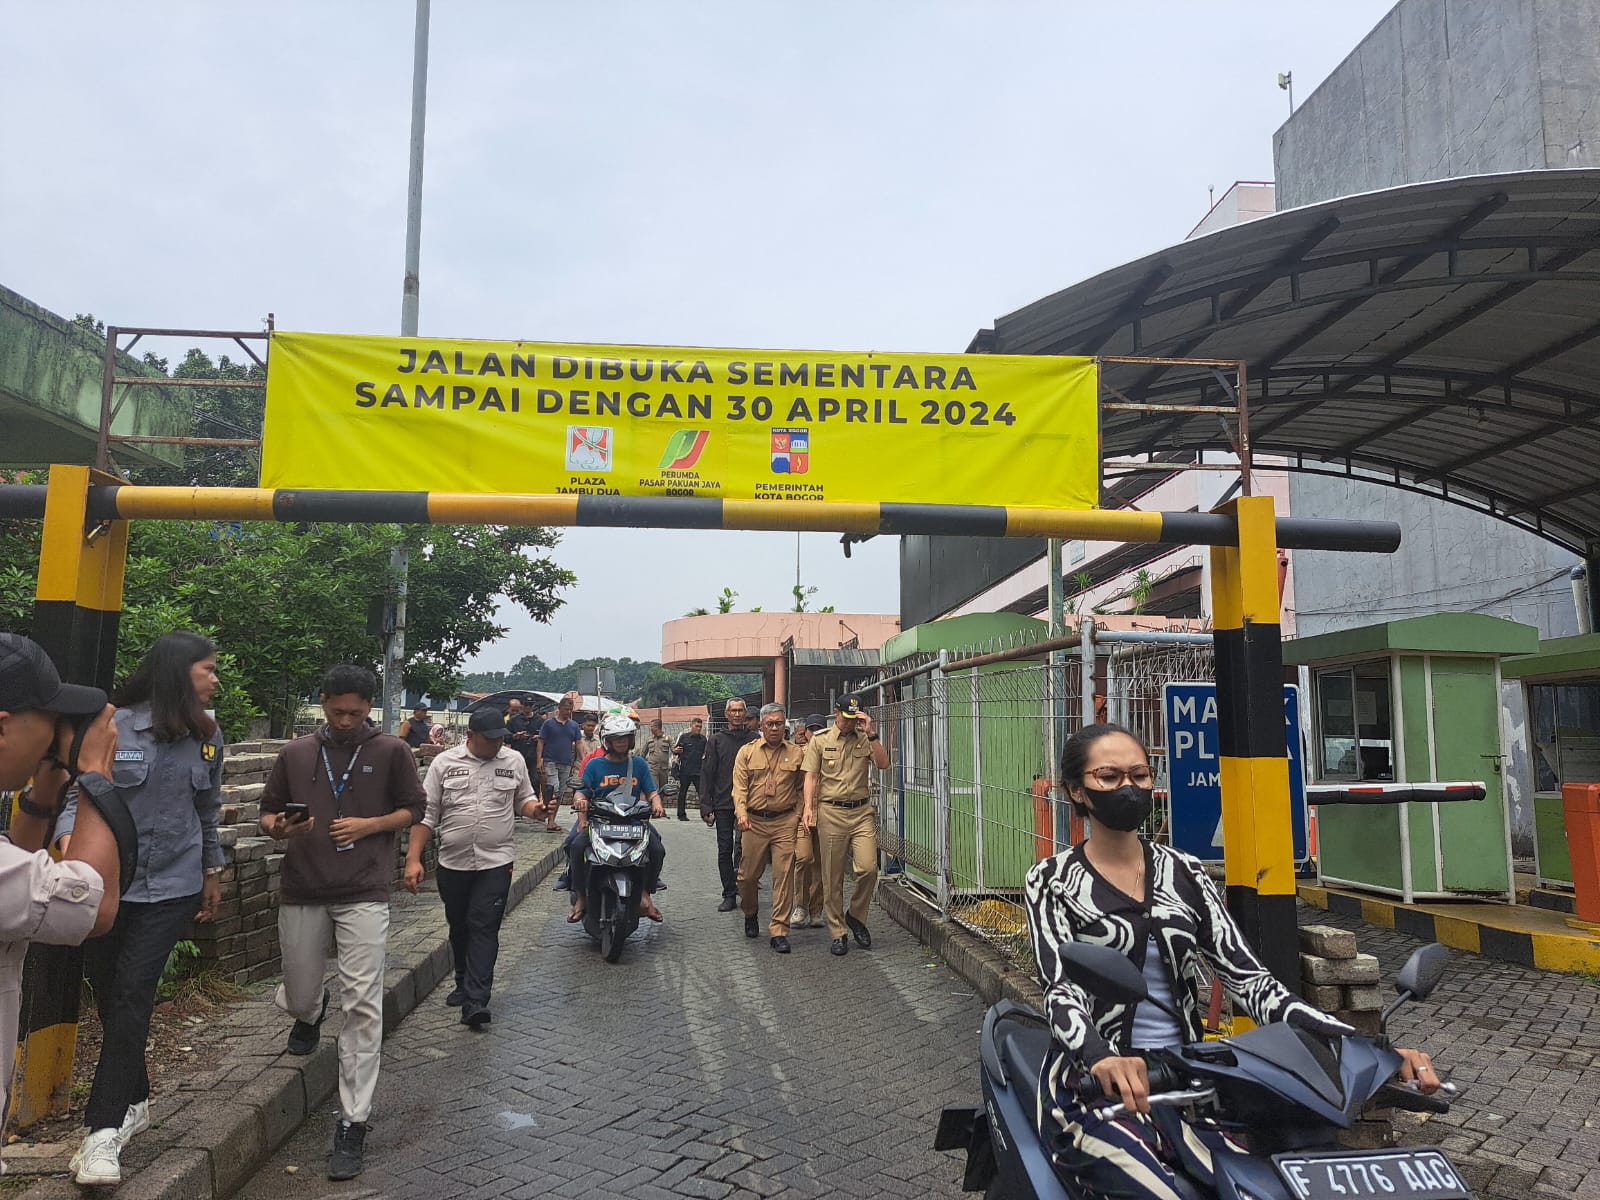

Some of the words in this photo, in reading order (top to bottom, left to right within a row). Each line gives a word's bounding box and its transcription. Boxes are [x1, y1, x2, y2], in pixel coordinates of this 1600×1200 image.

[396, 349, 535, 378] JALAN
[552, 355, 715, 384] DIBUKA
[727, 360, 978, 391] SEMENTARA
[355, 382, 520, 413] SAMPAI
[537, 389, 712, 420] DENGAN
[726, 395, 773, 422] 30
[786, 397, 909, 425] APRIL
[920, 399, 1017, 427] 2024
[661, 471, 700, 479] PERUMDA
[570, 477, 606, 486] PLAZA
[639, 479, 665, 487] PASAR
[667, 479, 699, 488] PAKUAN
[701, 480, 721, 489] JAYA
[555, 486, 594, 495] JAMBU
[596, 488, 620, 496] DUA
[755, 483, 824, 492] PEMERINTAH
[754, 492, 783, 500] KOTA
[785, 493, 824, 501] BOGOR
[1289, 1165, 1310, 1196] F
